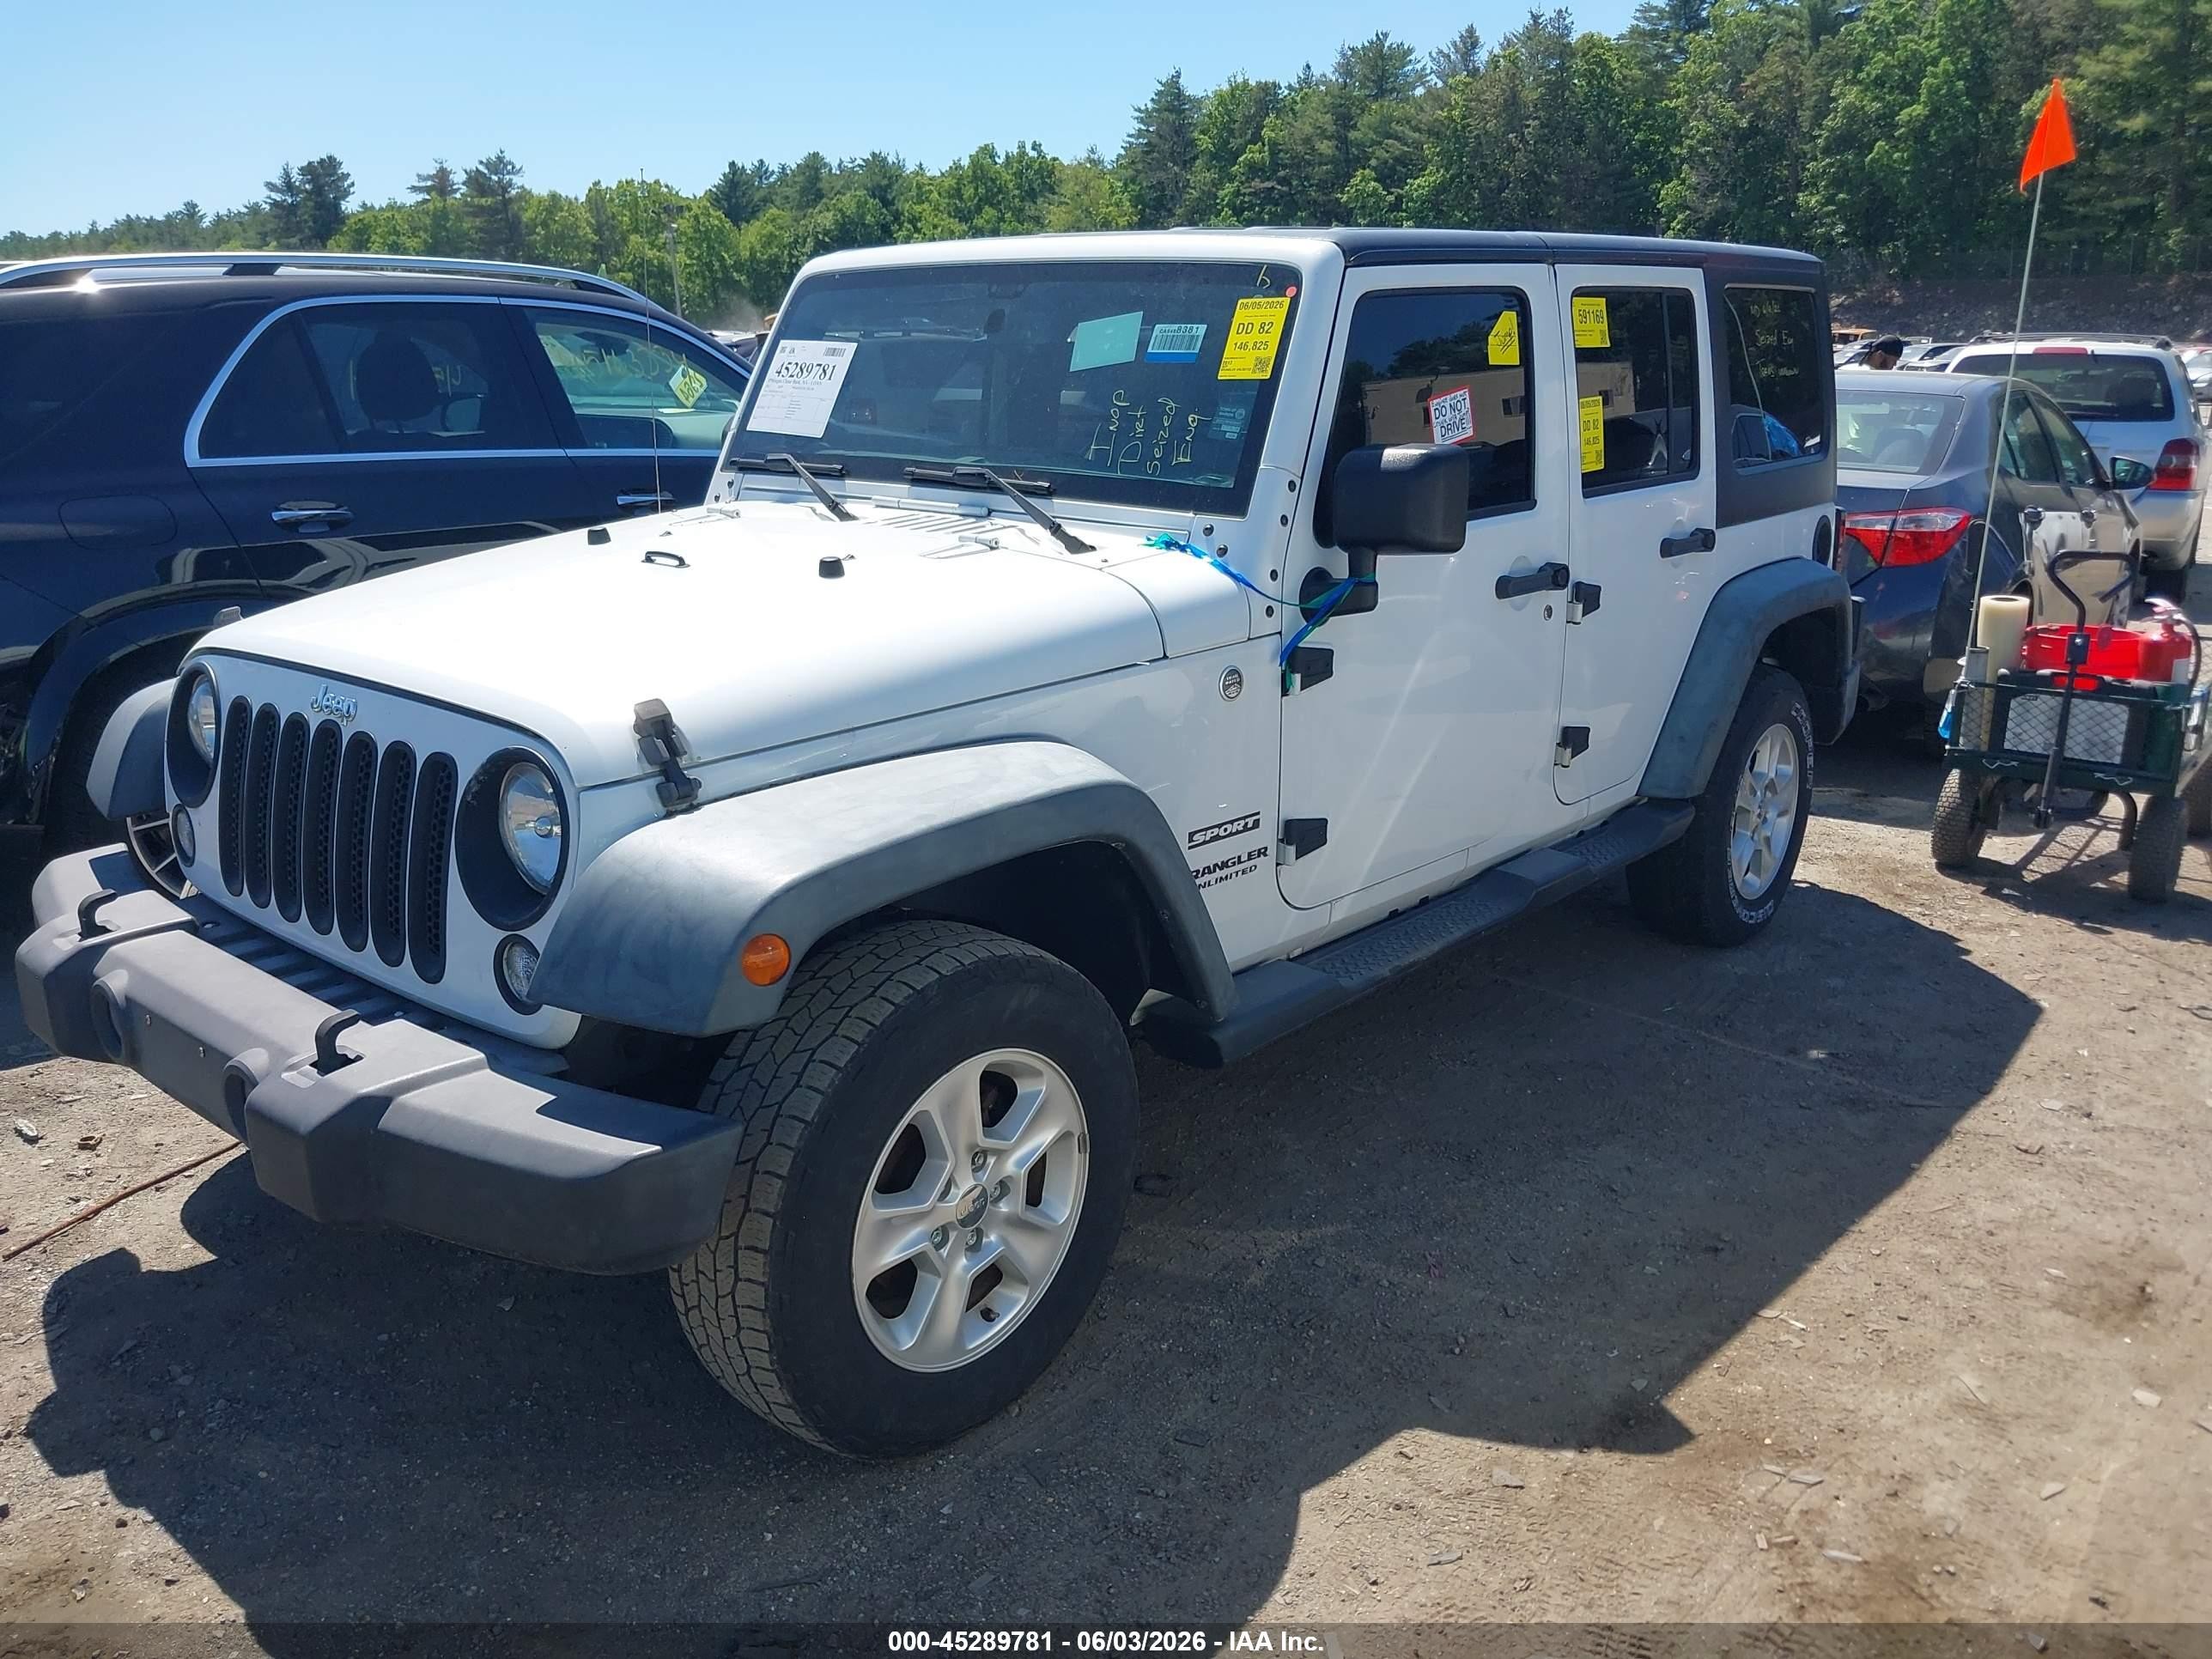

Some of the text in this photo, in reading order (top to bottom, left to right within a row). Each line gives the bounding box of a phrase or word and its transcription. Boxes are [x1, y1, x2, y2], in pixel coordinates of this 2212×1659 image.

[1238, 301, 1285, 311] 06/05/2026
[1577, 308, 1604, 325] 591169
[1236, 321, 1274, 335] DD 82
[1233, 341, 1270, 352] 146,825
[775, 361, 837, 381] 45289781
[1434, 404, 1447, 420] DO
[1449, 398, 1467, 415] NOT
[1440, 417, 1467, 438] DRIVE
[1583, 418, 1600, 432] DD 82
[310, 684, 358, 727] Jeep
[1188, 813, 1261, 848] SPORT
[1191, 846, 1269, 880] RANGLER
[1197, 864, 1258, 890] NLIMITED
